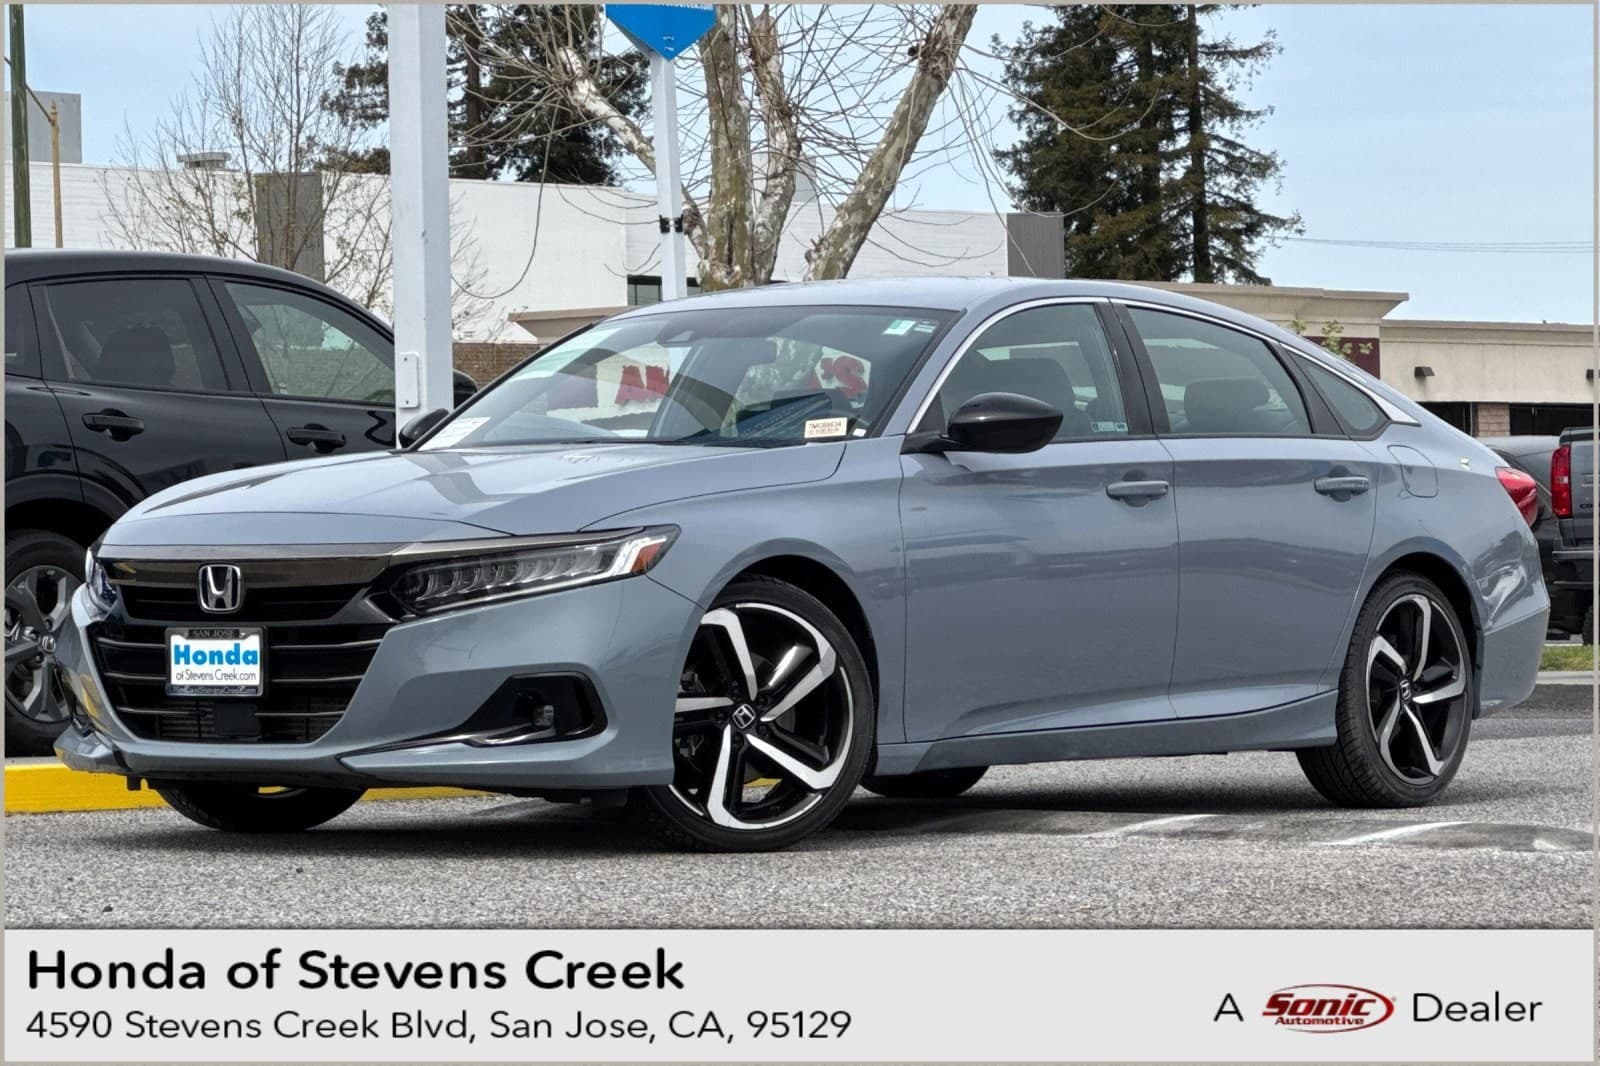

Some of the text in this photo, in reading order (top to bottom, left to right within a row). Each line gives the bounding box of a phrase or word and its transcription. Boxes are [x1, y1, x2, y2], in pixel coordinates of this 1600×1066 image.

[193, 629, 234, 638] SAN JOSE
[174, 643, 258, 665] Honda
[176, 668, 257, 681] of Stevens Creek.com
